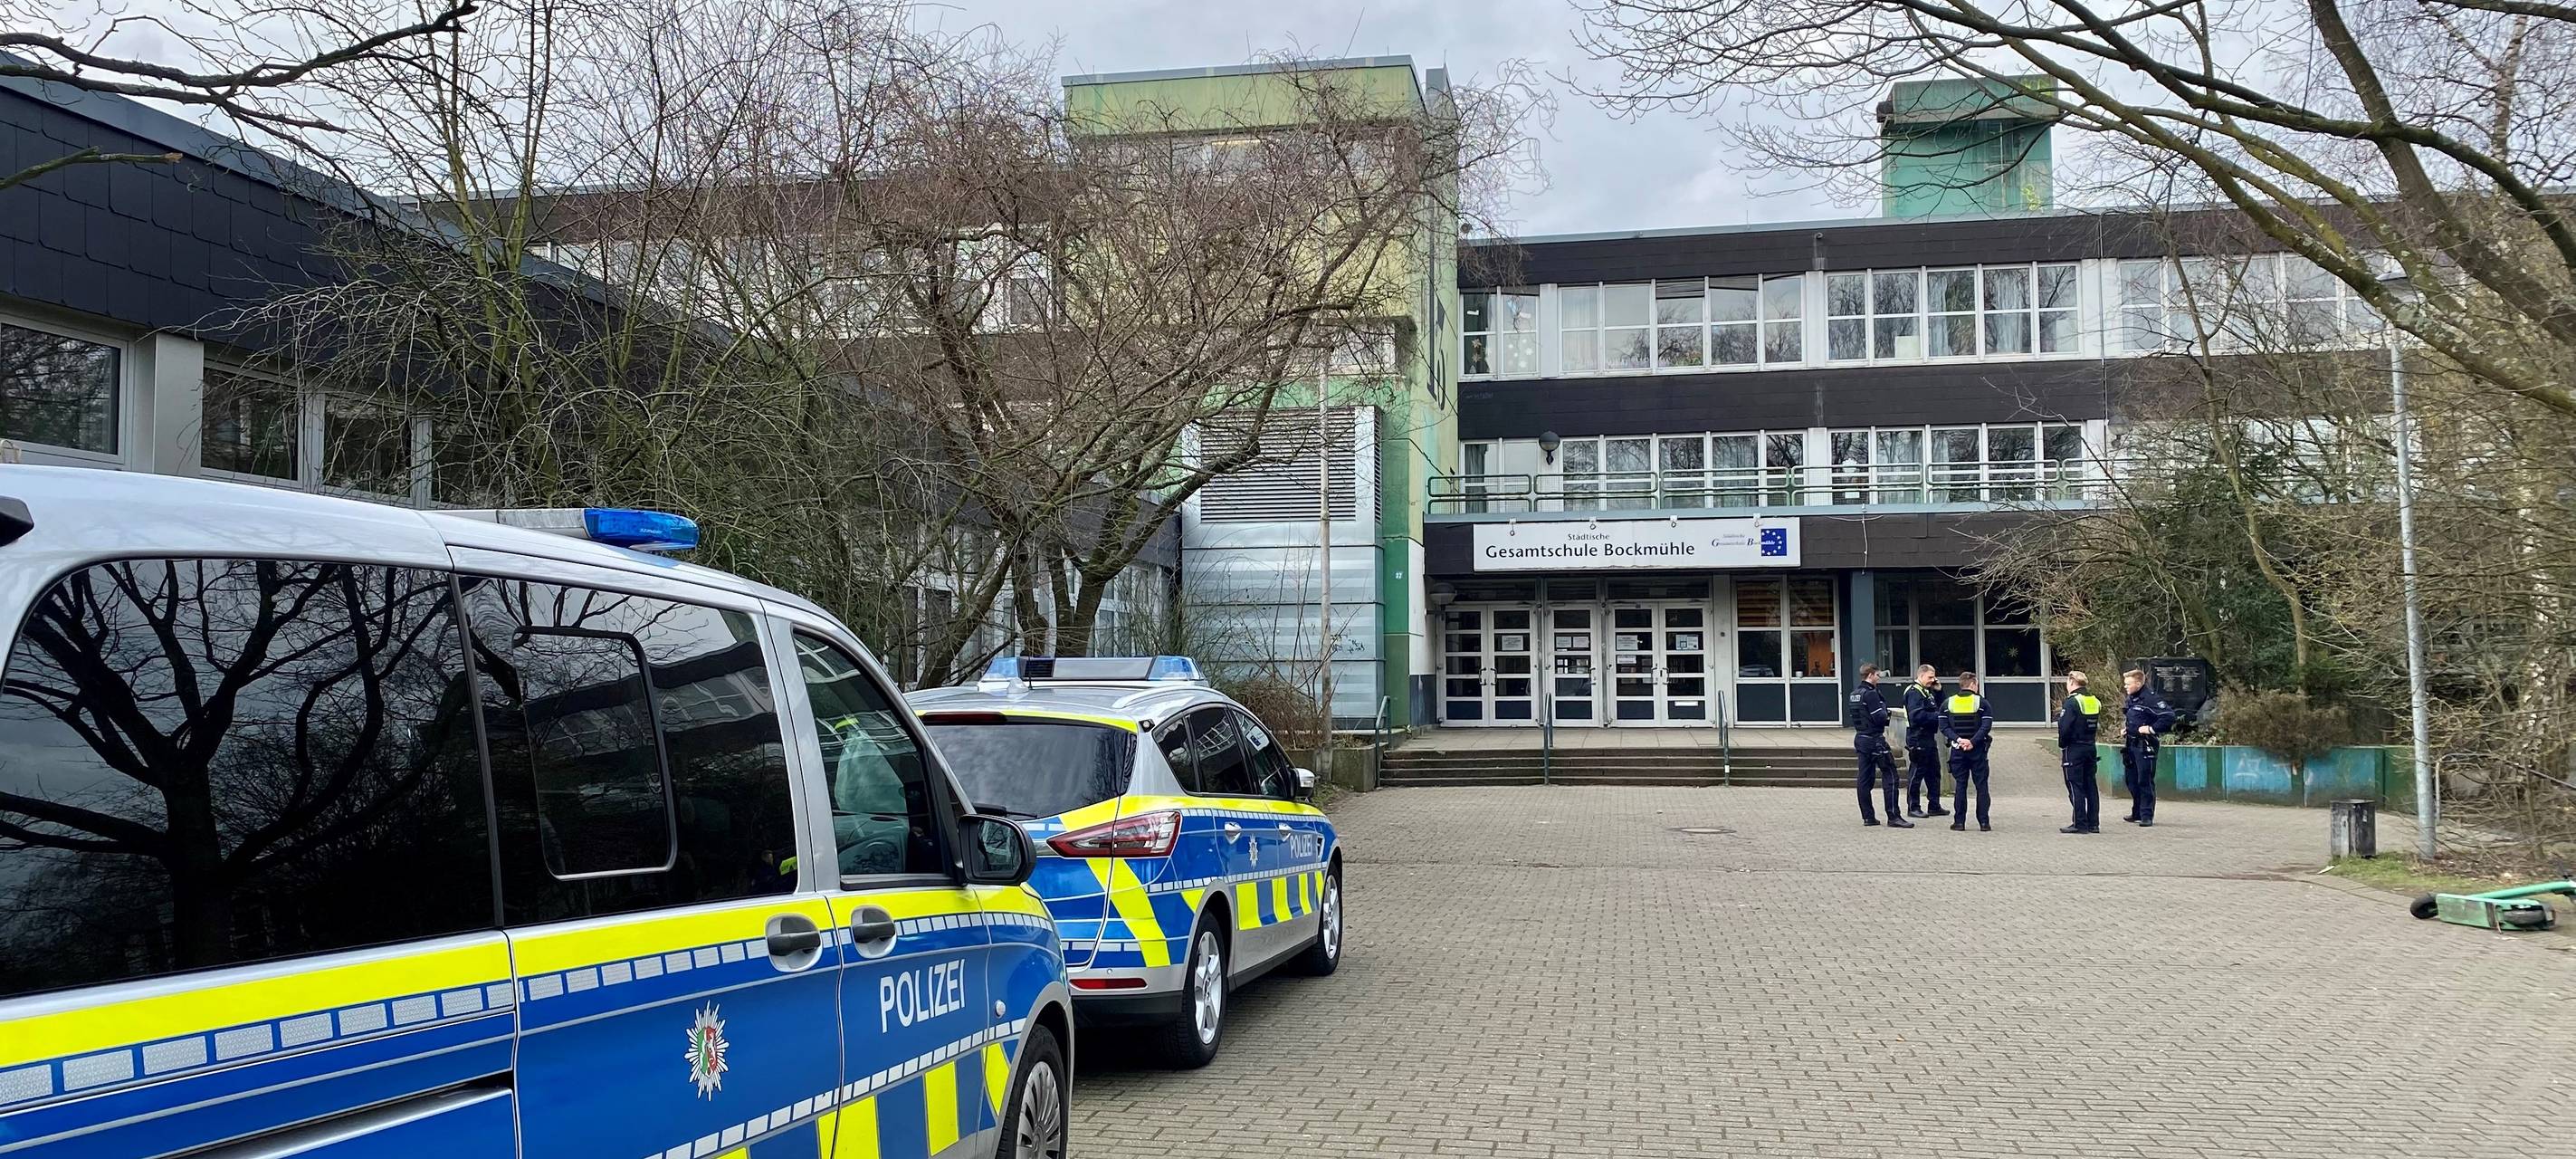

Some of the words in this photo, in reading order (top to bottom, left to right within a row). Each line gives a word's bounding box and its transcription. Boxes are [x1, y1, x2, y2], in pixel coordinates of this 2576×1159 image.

[1568, 532, 1610, 541] Städtische
[1485, 542, 1598, 559] Gesamtschule
[1604, 541, 1695, 556] Bockmühle
[1289, 834, 1312, 859] POLIZEI
[880, 959, 966, 1033] POLIZEI
